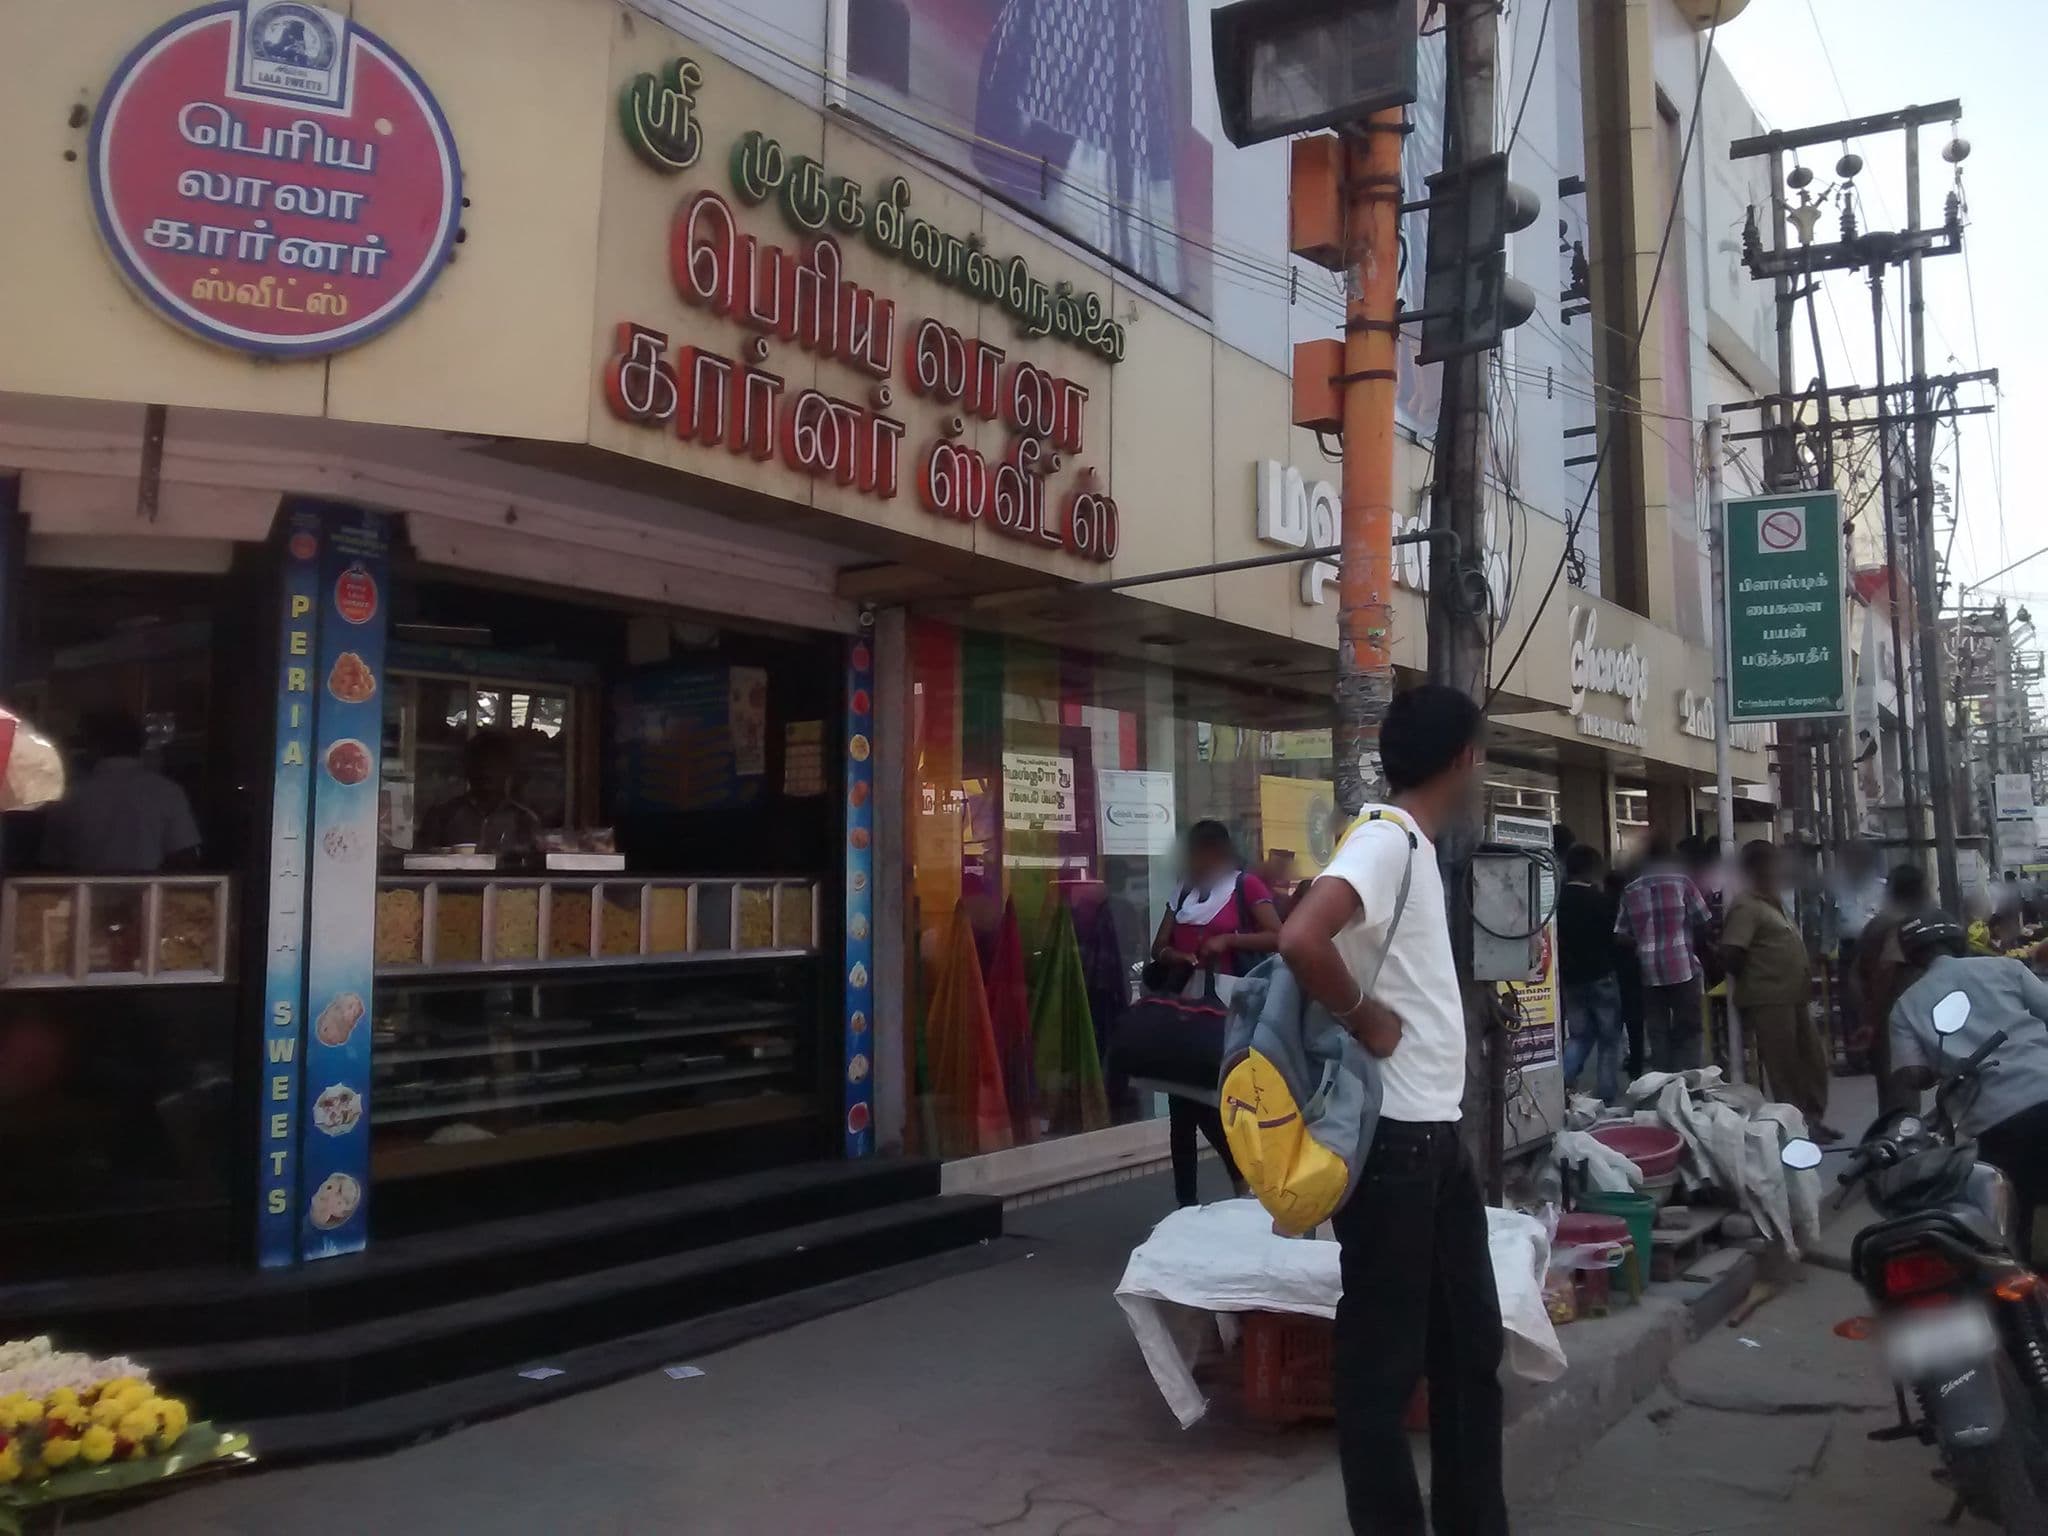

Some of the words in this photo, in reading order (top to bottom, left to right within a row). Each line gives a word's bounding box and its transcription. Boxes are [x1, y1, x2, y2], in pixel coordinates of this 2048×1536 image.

[176, 101, 375, 171] பெரிய
[177, 169, 365, 220] லாலா
[143, 219, 387, 276] கார்னர்
[191, 267, 348, 316] ஸ்வீட்ஸ்
[671, 190, 896, 378] பெரிய
[907, 318, 1089, 454] லாலா
[606, 322, 906, 498] கார்னர்
[267, 1001, 296, 1216] SWEETS
